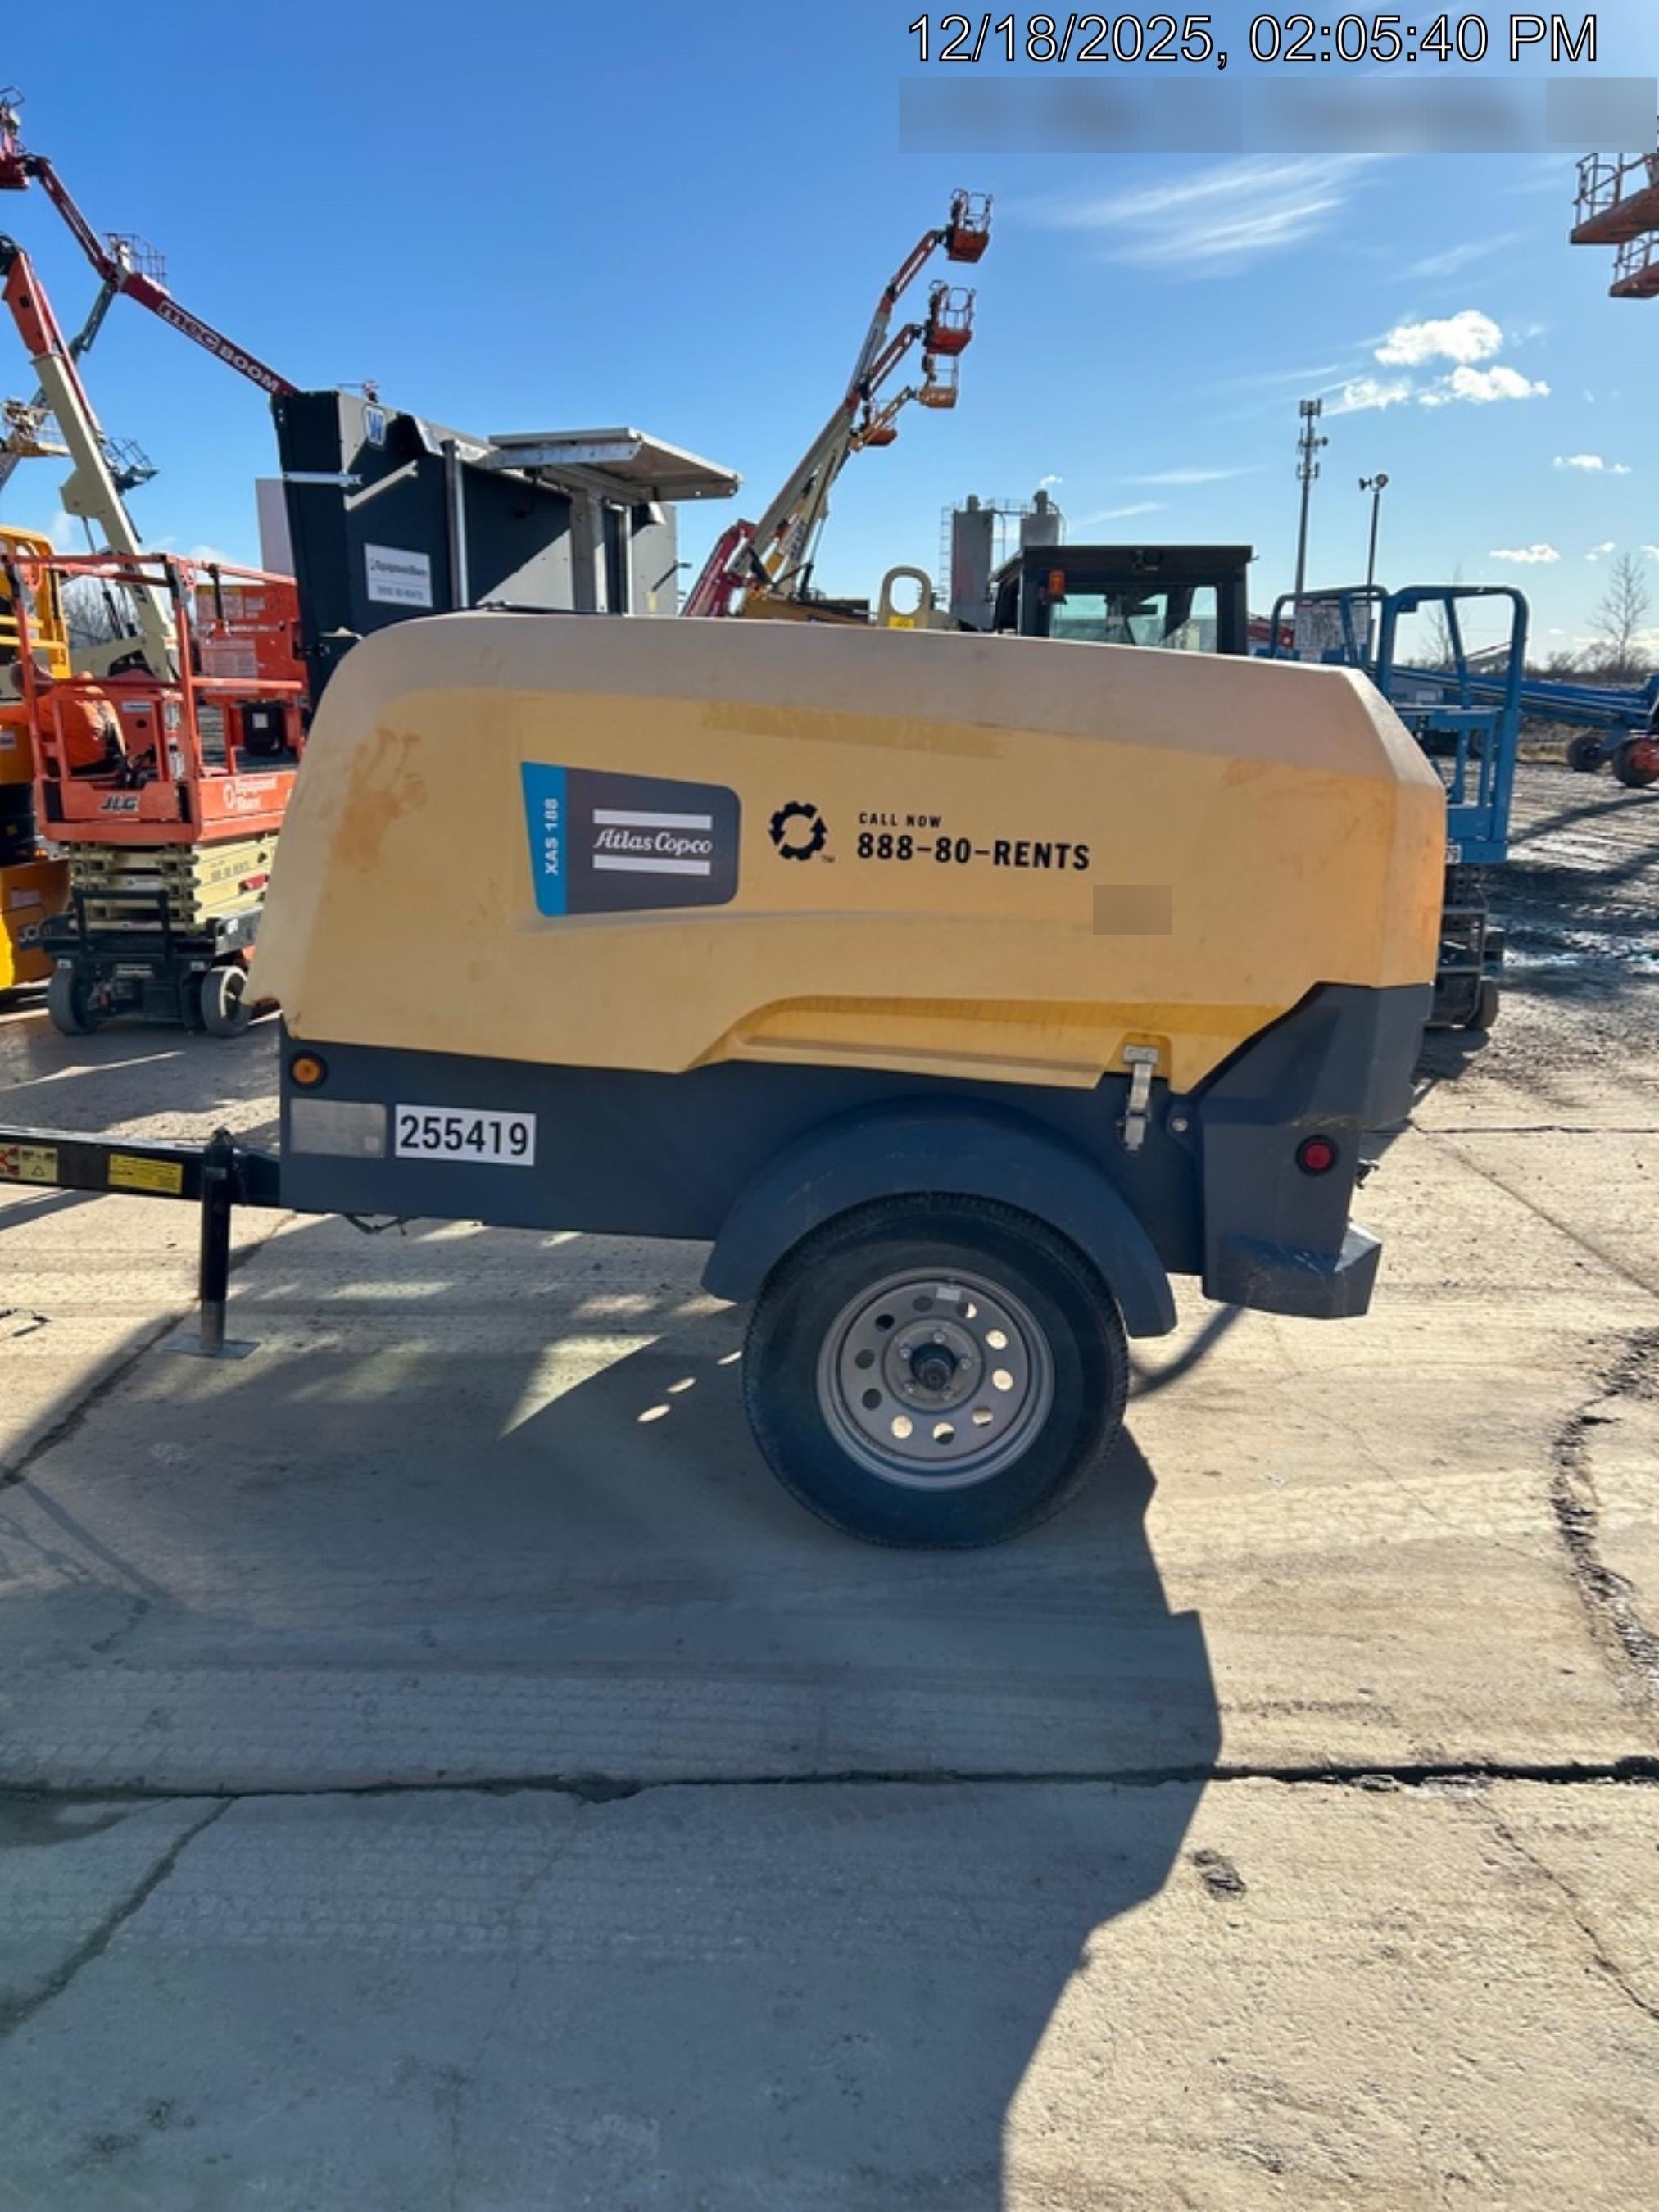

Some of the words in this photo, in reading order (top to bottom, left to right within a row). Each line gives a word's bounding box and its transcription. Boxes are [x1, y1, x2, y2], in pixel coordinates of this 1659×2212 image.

[220, 343, 280, 392] BOOM
[100, 795, 138, 810] JLG
[544, 797, 559, 832] 188
[858, 811, 898, 827] CALL
[906, 814, 942, 828] NOW
[544, 837, 559, 876] XAS
[857, 832, 1090, 871] 888-80-RENTS
[400, 1115, 528, 1157] 255419
